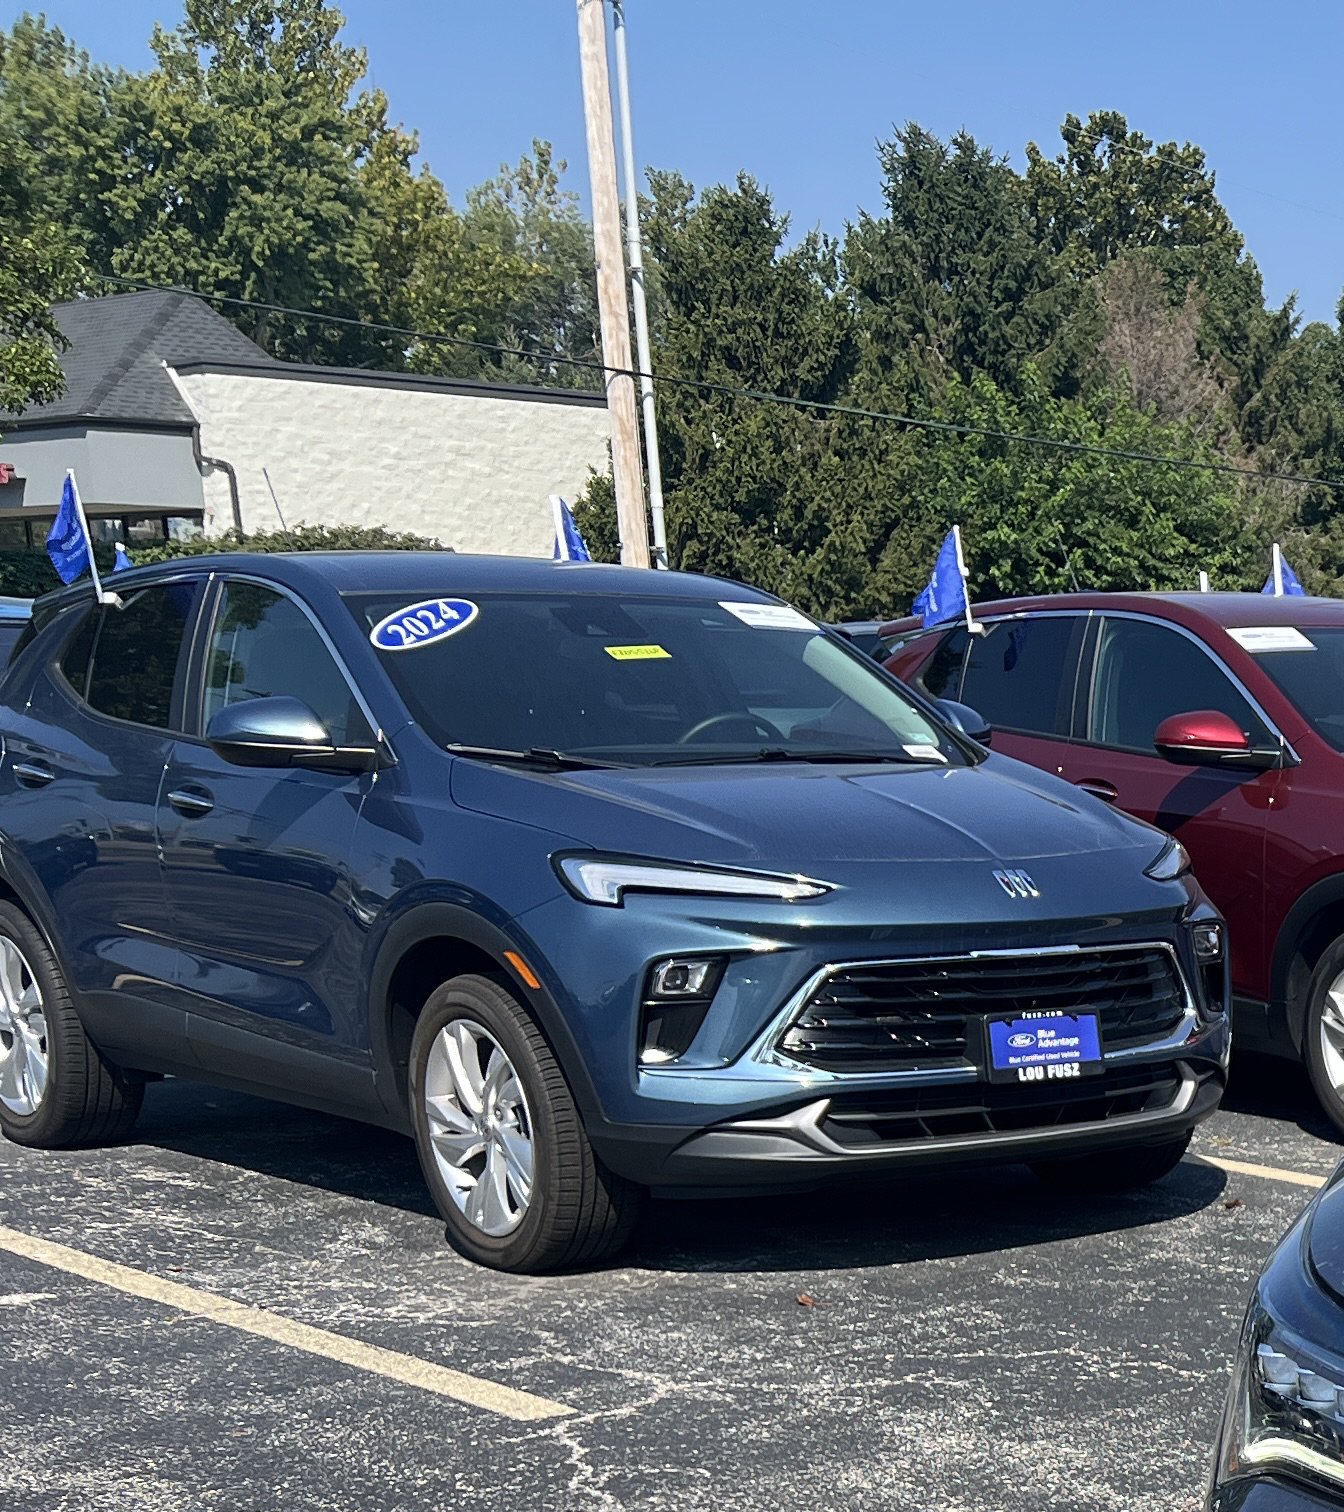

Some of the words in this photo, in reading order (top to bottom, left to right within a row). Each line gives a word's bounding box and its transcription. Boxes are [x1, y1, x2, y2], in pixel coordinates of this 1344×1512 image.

[386, 601, 461, 646] 2024
[1037, 1029, 1056, 1038] Blue
[1037, 1037, 1080, 1048] Advantage
[1018, 1066, 1044, 1081] LOU
[1047, 1062, 1080, 1079] FUSZ
